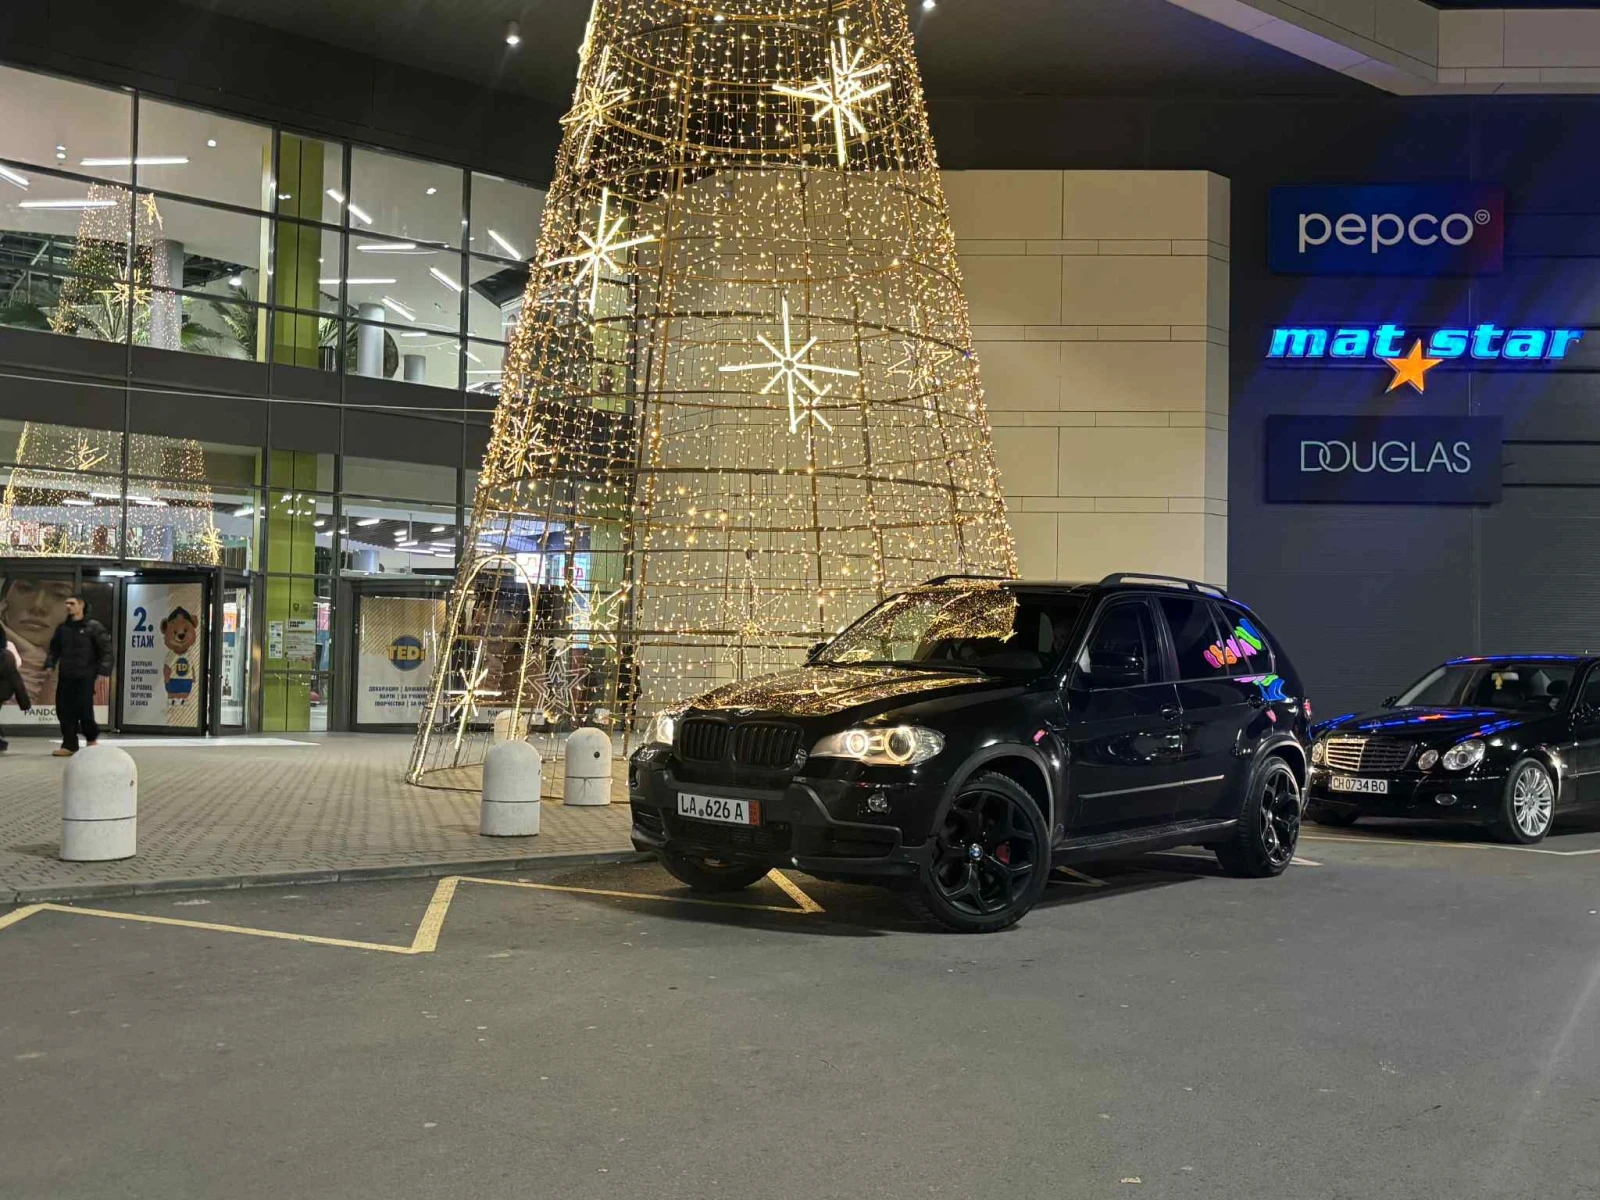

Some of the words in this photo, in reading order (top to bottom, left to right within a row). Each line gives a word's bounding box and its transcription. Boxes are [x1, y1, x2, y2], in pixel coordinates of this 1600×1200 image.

[1298, 213, 1474, 254] pepco
[1266, 323, 1405, 359] mat
[1426, 323, 1584, 360] star
[1300, 440, 1471, 473] DOUGLAS
[133, 606, 153, 632] 2.
[131, 635, 154, 648] ЕТАЖ
[24, 708, 57, 716] PANDO
[705, 799, 731, 819] 626
[734, 803, 743, 820] A
